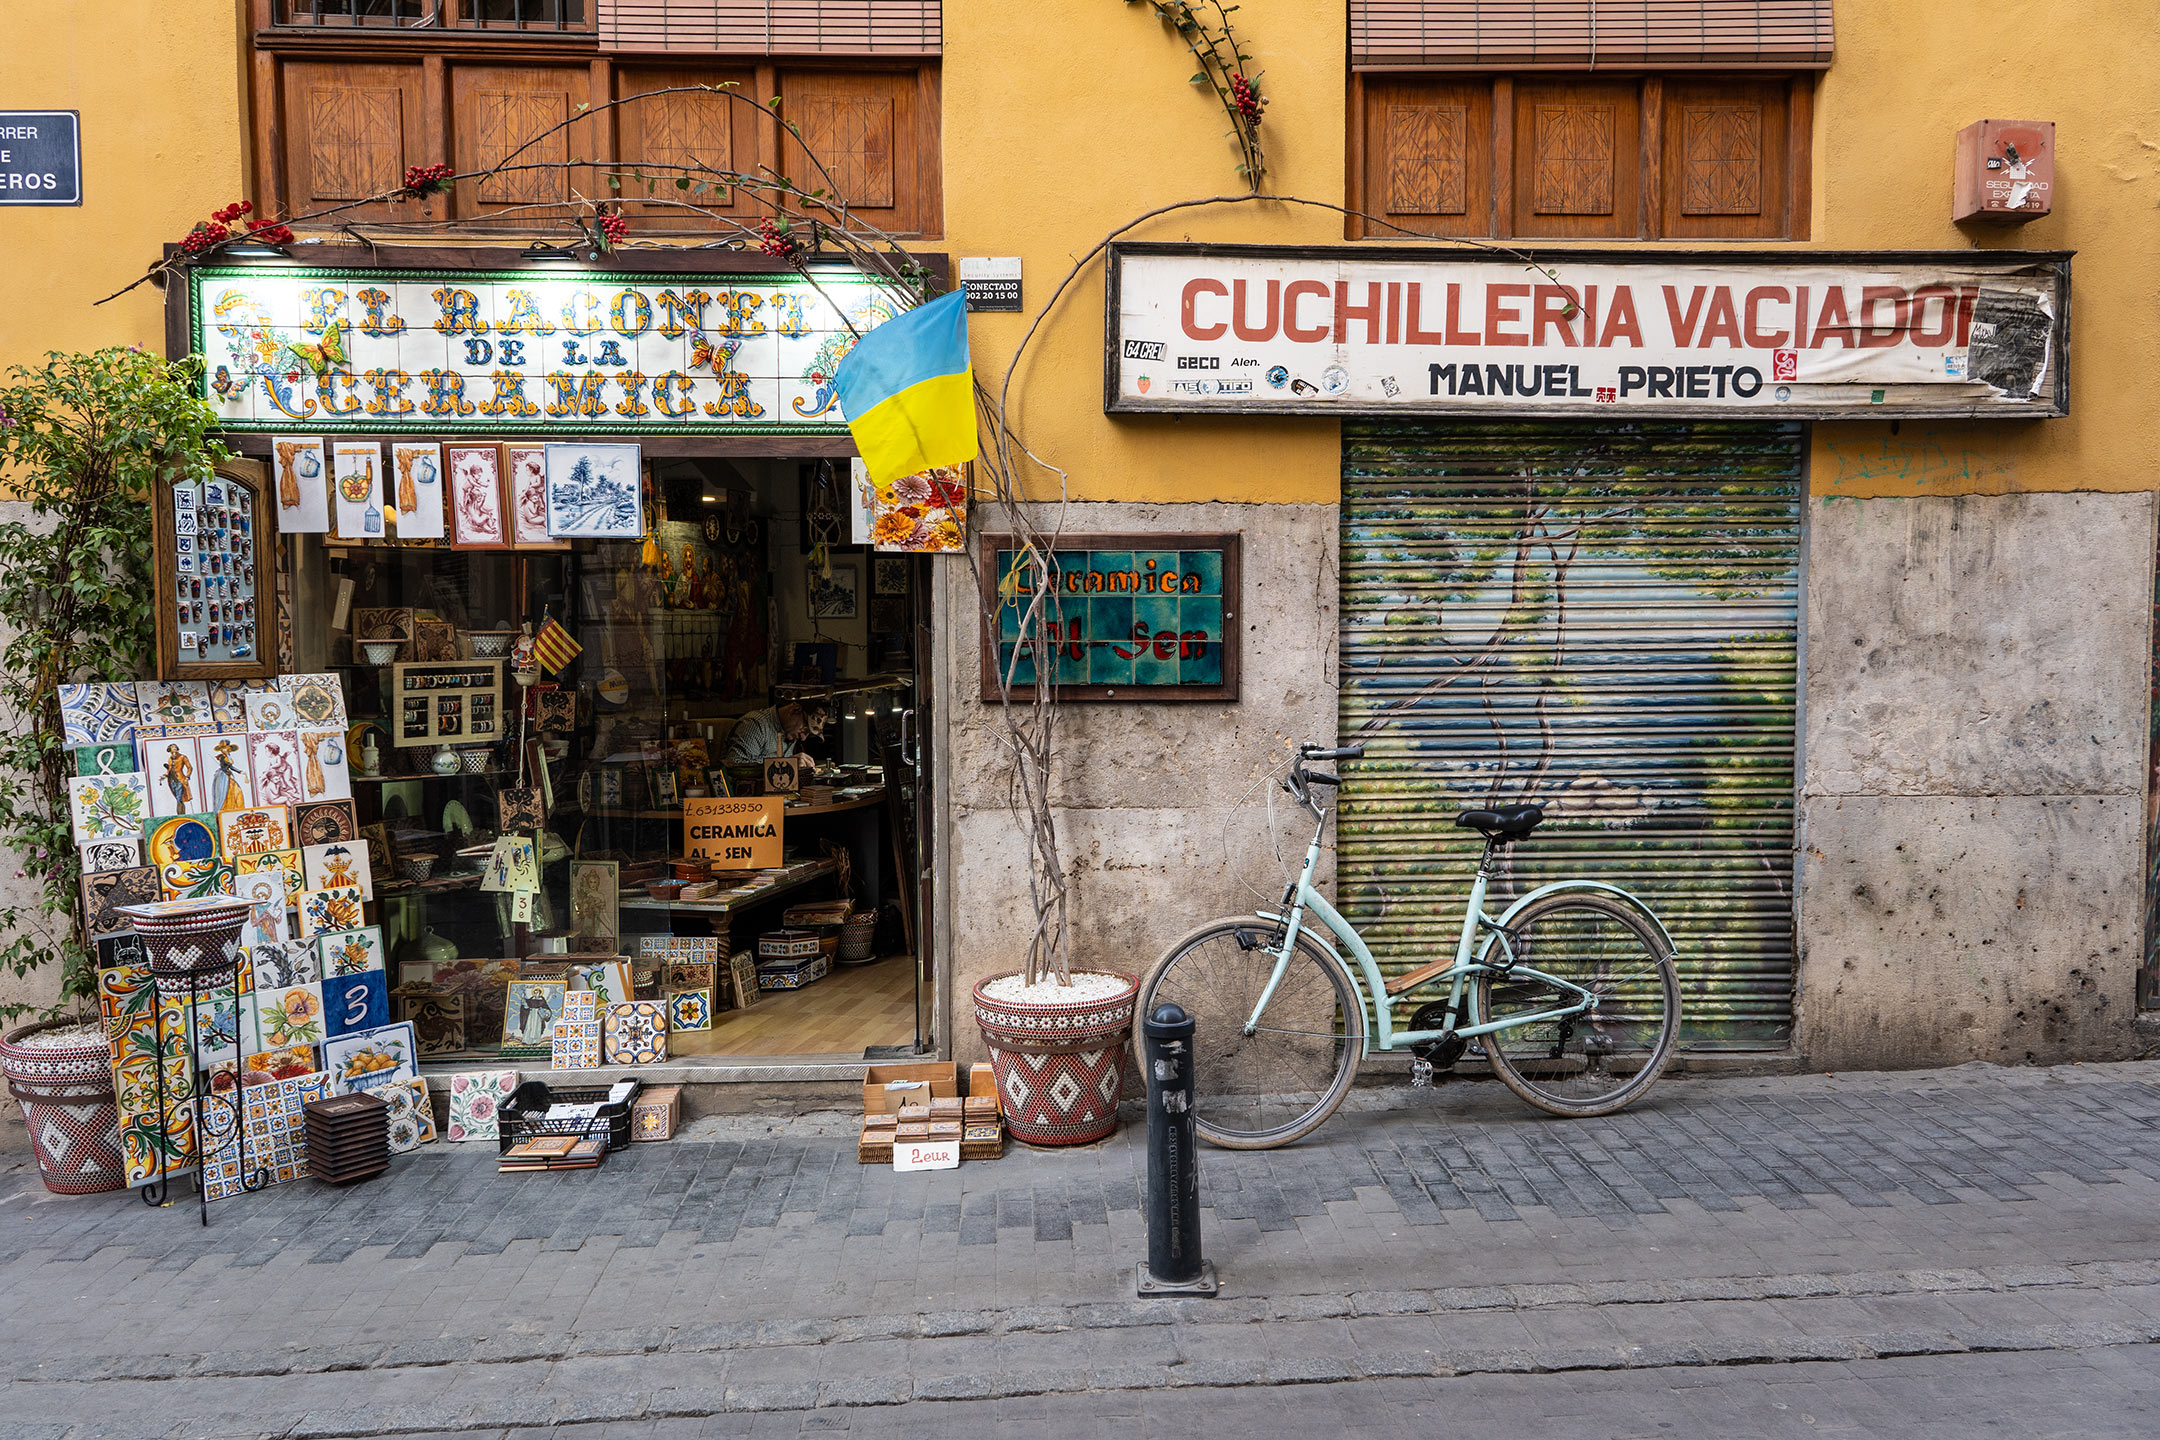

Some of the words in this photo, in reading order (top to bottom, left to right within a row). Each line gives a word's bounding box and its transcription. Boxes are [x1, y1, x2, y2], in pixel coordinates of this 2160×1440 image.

[302, 287, 407, 338] EL
[432, 287, 815, 339] RACONET
[1180, 278, 1644, 348] CUCHILLERIA
[463, 338, 527, 365] DE
[562, 339, 628, 366] LA
[1126, 341, 1140, 358] 64
[316, 368, 767, 417] CERAMICA
[1429, 362, 1593, 397] MANUEL
[1618, 364, 1763, 398] PRIETO
[690, 824, 777, 839] CERAMICA
[691, 848, 710, 860] AL
[725, 847, 752, 859] SEN
[519, 897, 527, 909] 3
[344, 985, 369, 1025] 3
